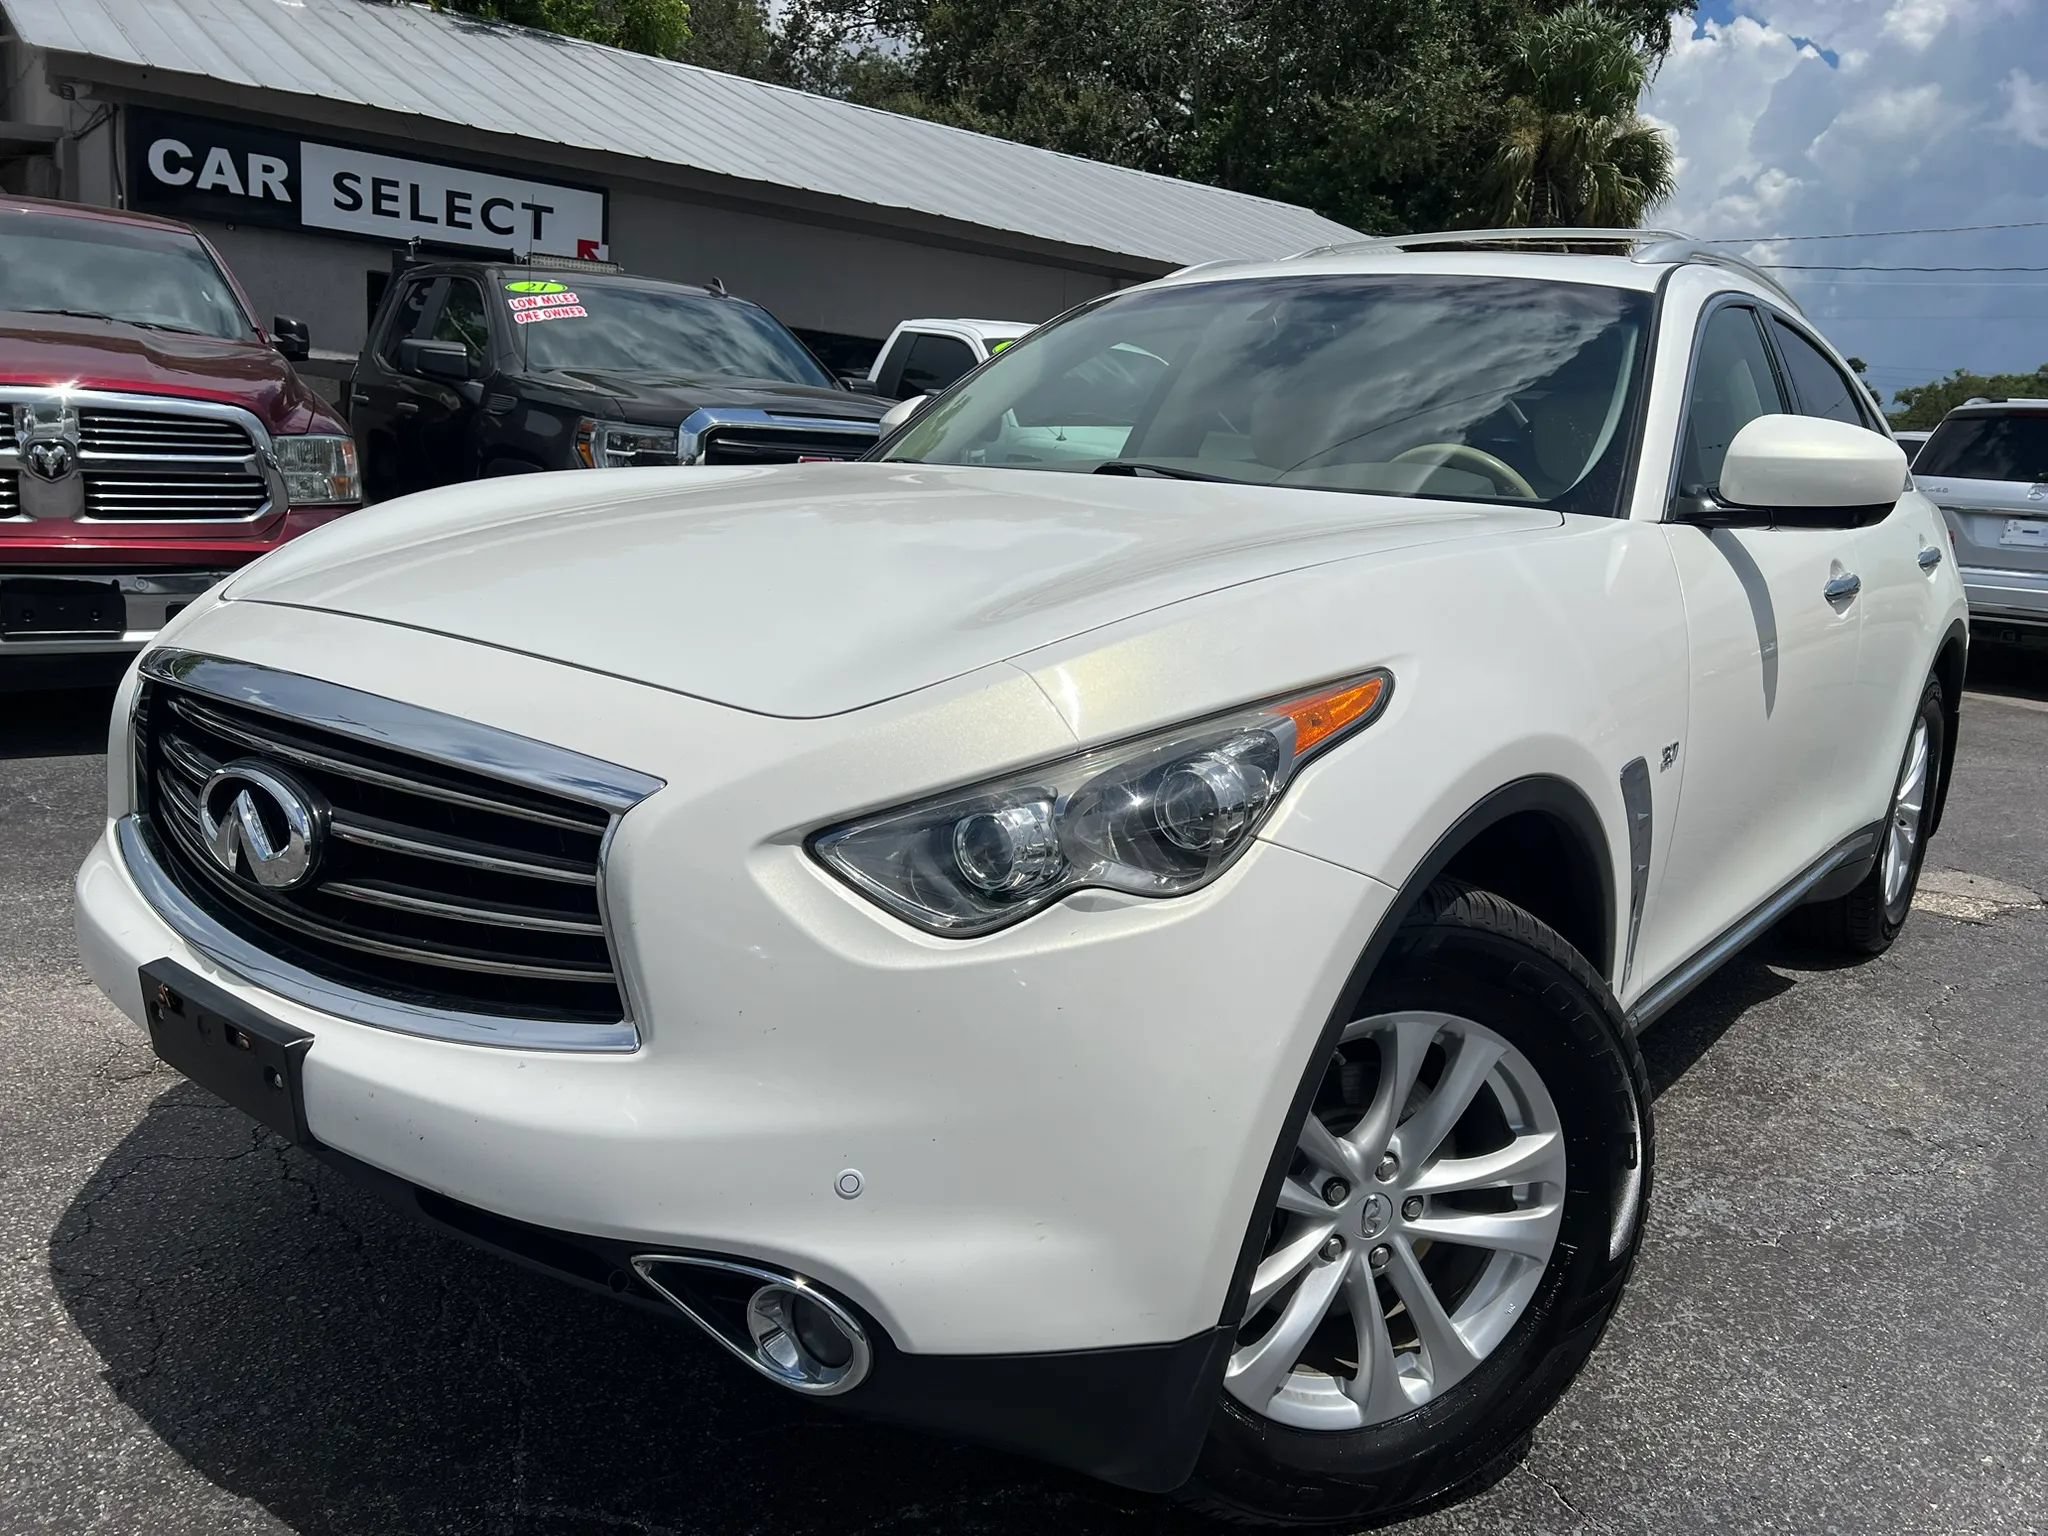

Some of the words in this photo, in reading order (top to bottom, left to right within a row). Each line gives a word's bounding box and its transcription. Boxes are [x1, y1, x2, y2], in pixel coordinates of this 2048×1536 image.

[148, 138, 292, 202] CAR
[333, 172, 554, 240] SELECT
[510, 298, 538, 310] LOW
[541, 294, 578, 304] MILES
[516, 312, 541, 323] ONE
[543, 307, 584, 318] OWNER
